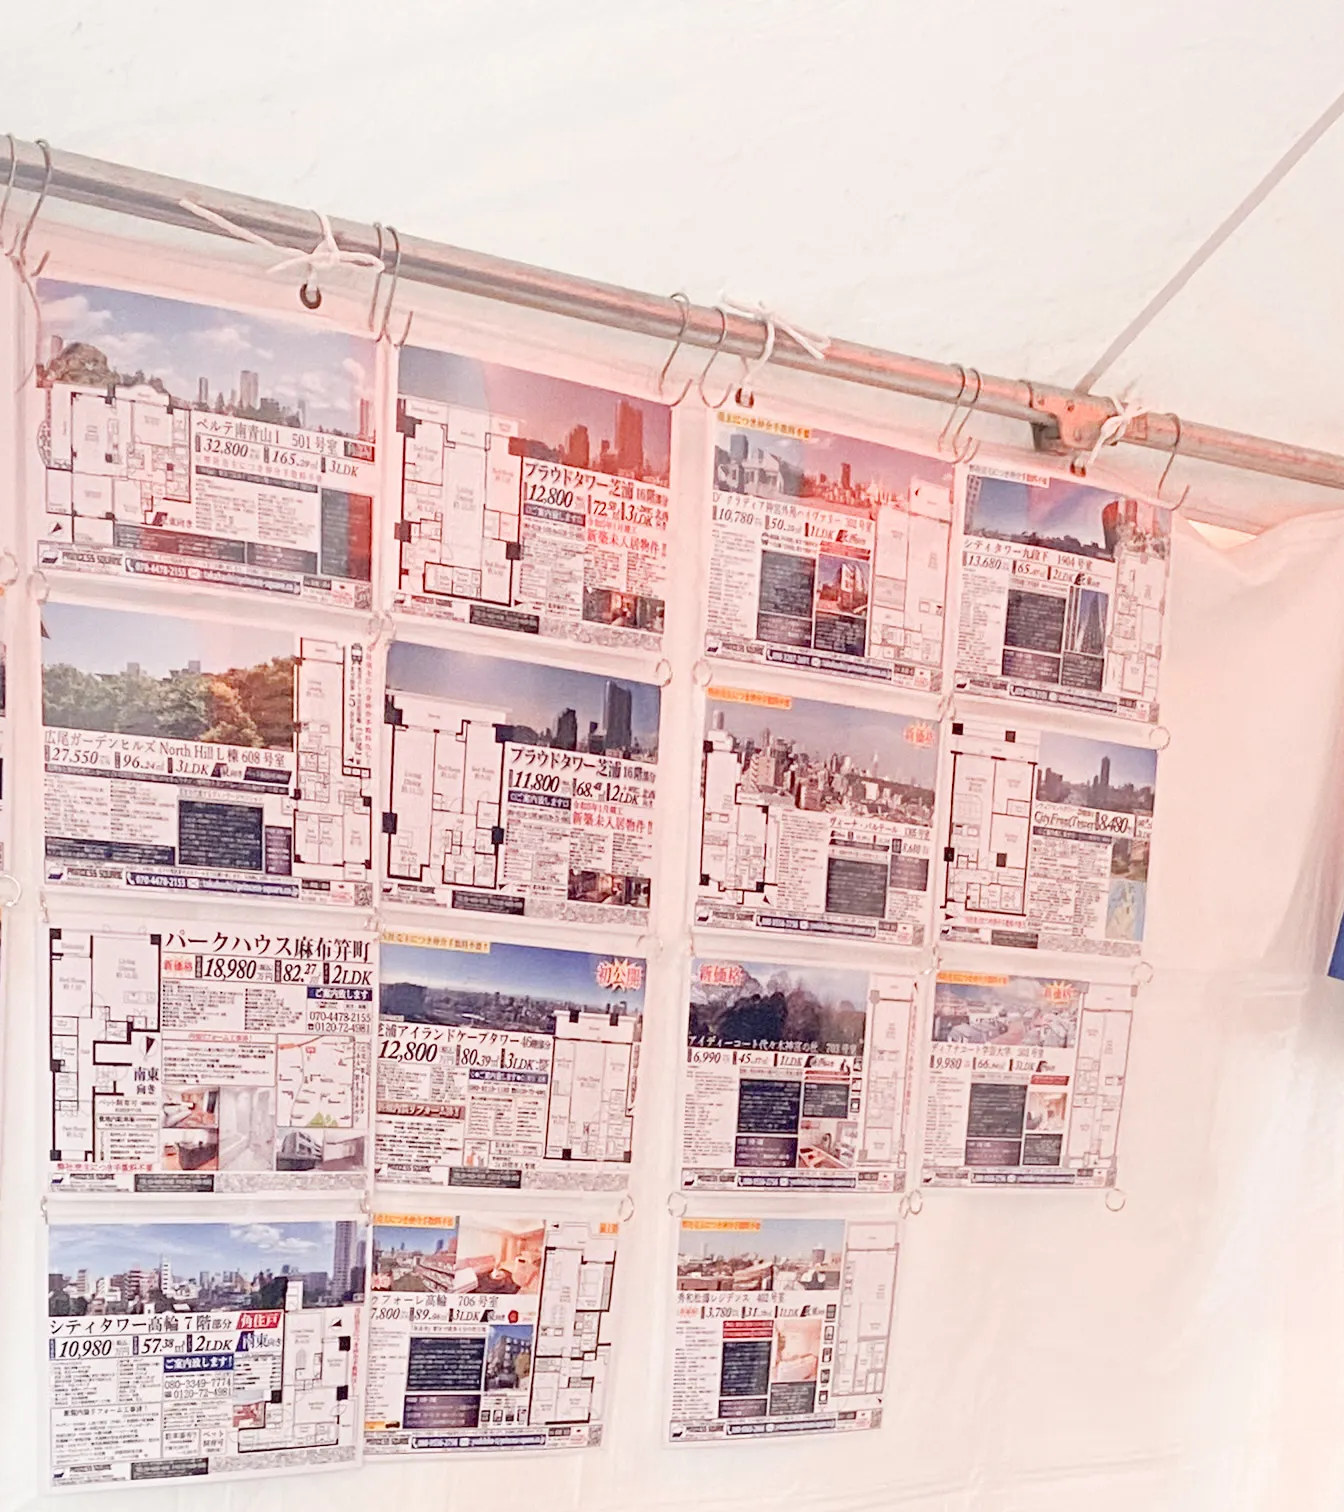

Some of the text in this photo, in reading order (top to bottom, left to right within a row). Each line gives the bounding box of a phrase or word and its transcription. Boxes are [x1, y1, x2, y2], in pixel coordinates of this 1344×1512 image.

[329, 461, 360, 477] 3LDK
[529, 484, 574, 507] 12,800
[44, 730, 155, 753] 広尾ガーデンヒルズ
[159, 741, 191, 757] North
[176, 759, 208, 775] 3LDK
[511, 747, 621, 779] プラウドタワー芝浦
[513, 771, 560, 793] 11,800
[206, 958, 256, 981] 18,980
[332, 965, 372, 985] 2LDK
[598, 963, 642, 987] 初公開
[378, 1039, 438, 1063] 12,800
[137, 1084, 156, 1094] 向き
[59, 1339, 111, 1359] 10,980
[194, 1335, 232, 1352] 2LDK
